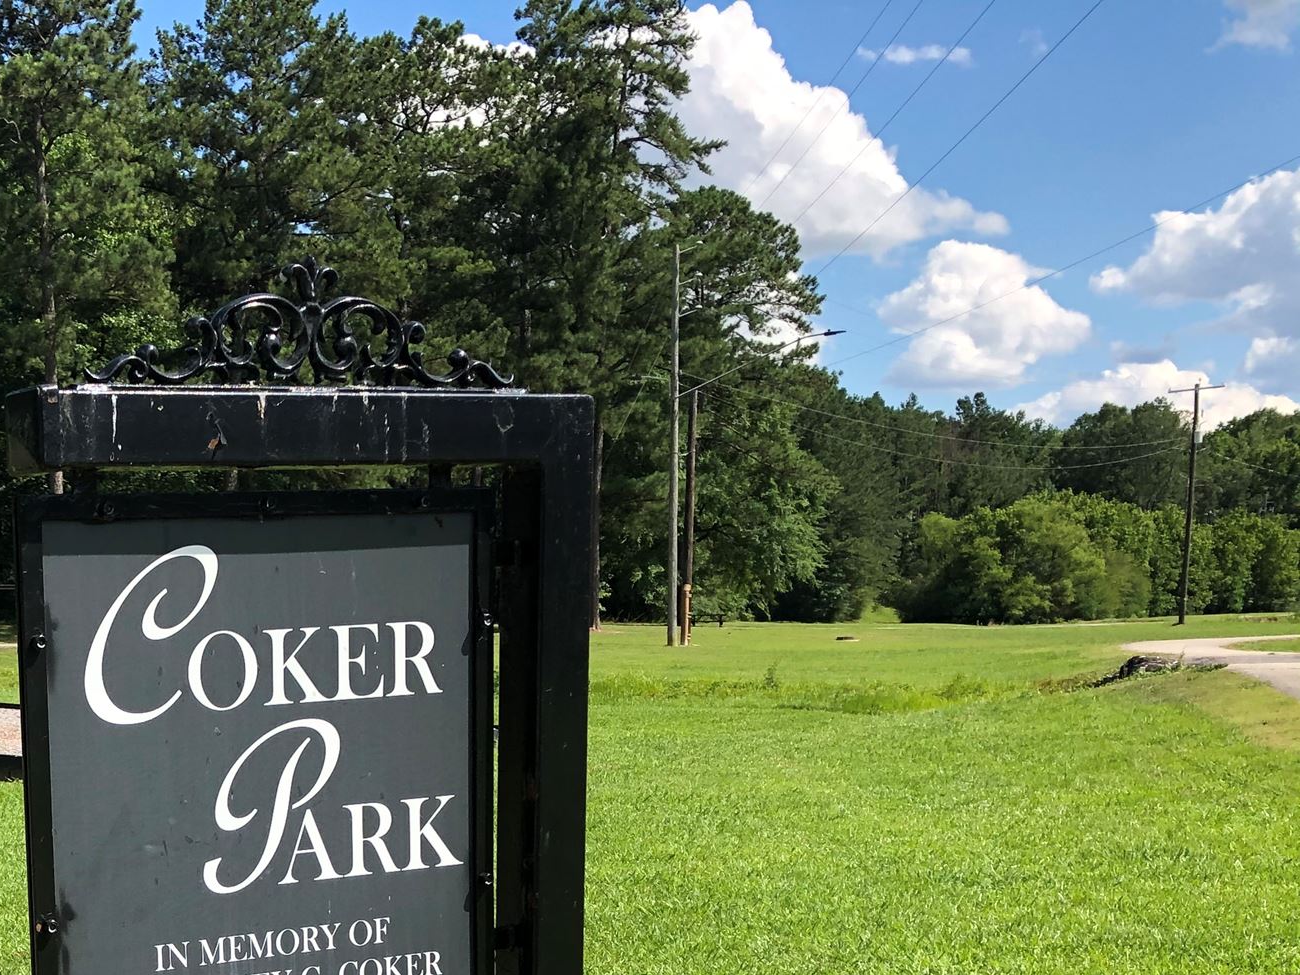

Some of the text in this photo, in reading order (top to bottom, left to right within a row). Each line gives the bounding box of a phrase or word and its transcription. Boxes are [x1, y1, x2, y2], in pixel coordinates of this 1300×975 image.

[84, 545, 444, 725] COKER
[203, 717, 464, 895] PARK
[155, 916, 391, 972] IN MEMORY OF
